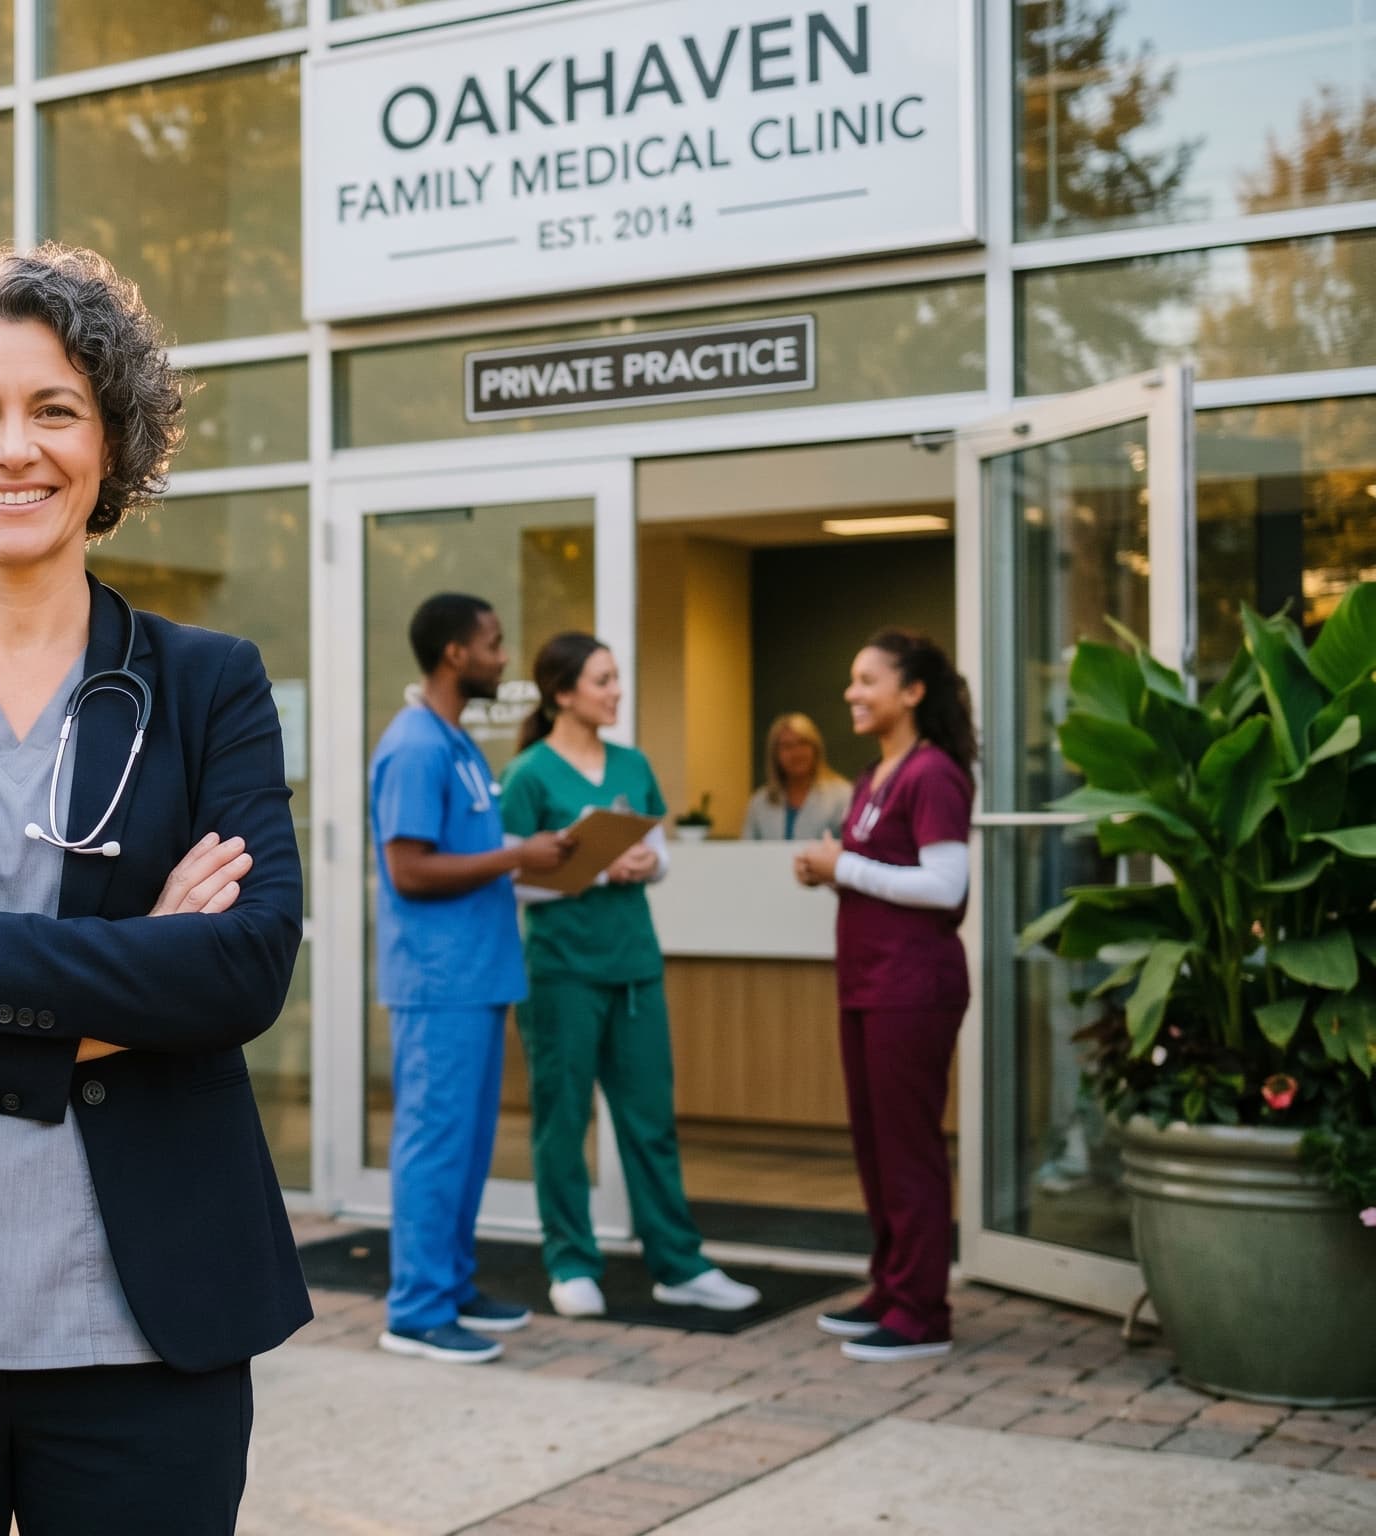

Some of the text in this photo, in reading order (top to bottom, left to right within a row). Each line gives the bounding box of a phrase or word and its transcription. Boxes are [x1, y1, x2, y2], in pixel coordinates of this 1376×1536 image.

[380, 3, 871, 152] OAKHAVEN
[338, 94, 926, 222] FAMILY MEDICAL CLINIC
[538, 203, 694, 250] EST. 2014
[481, 336, 797, 399] PRIVATE PRACTICE
